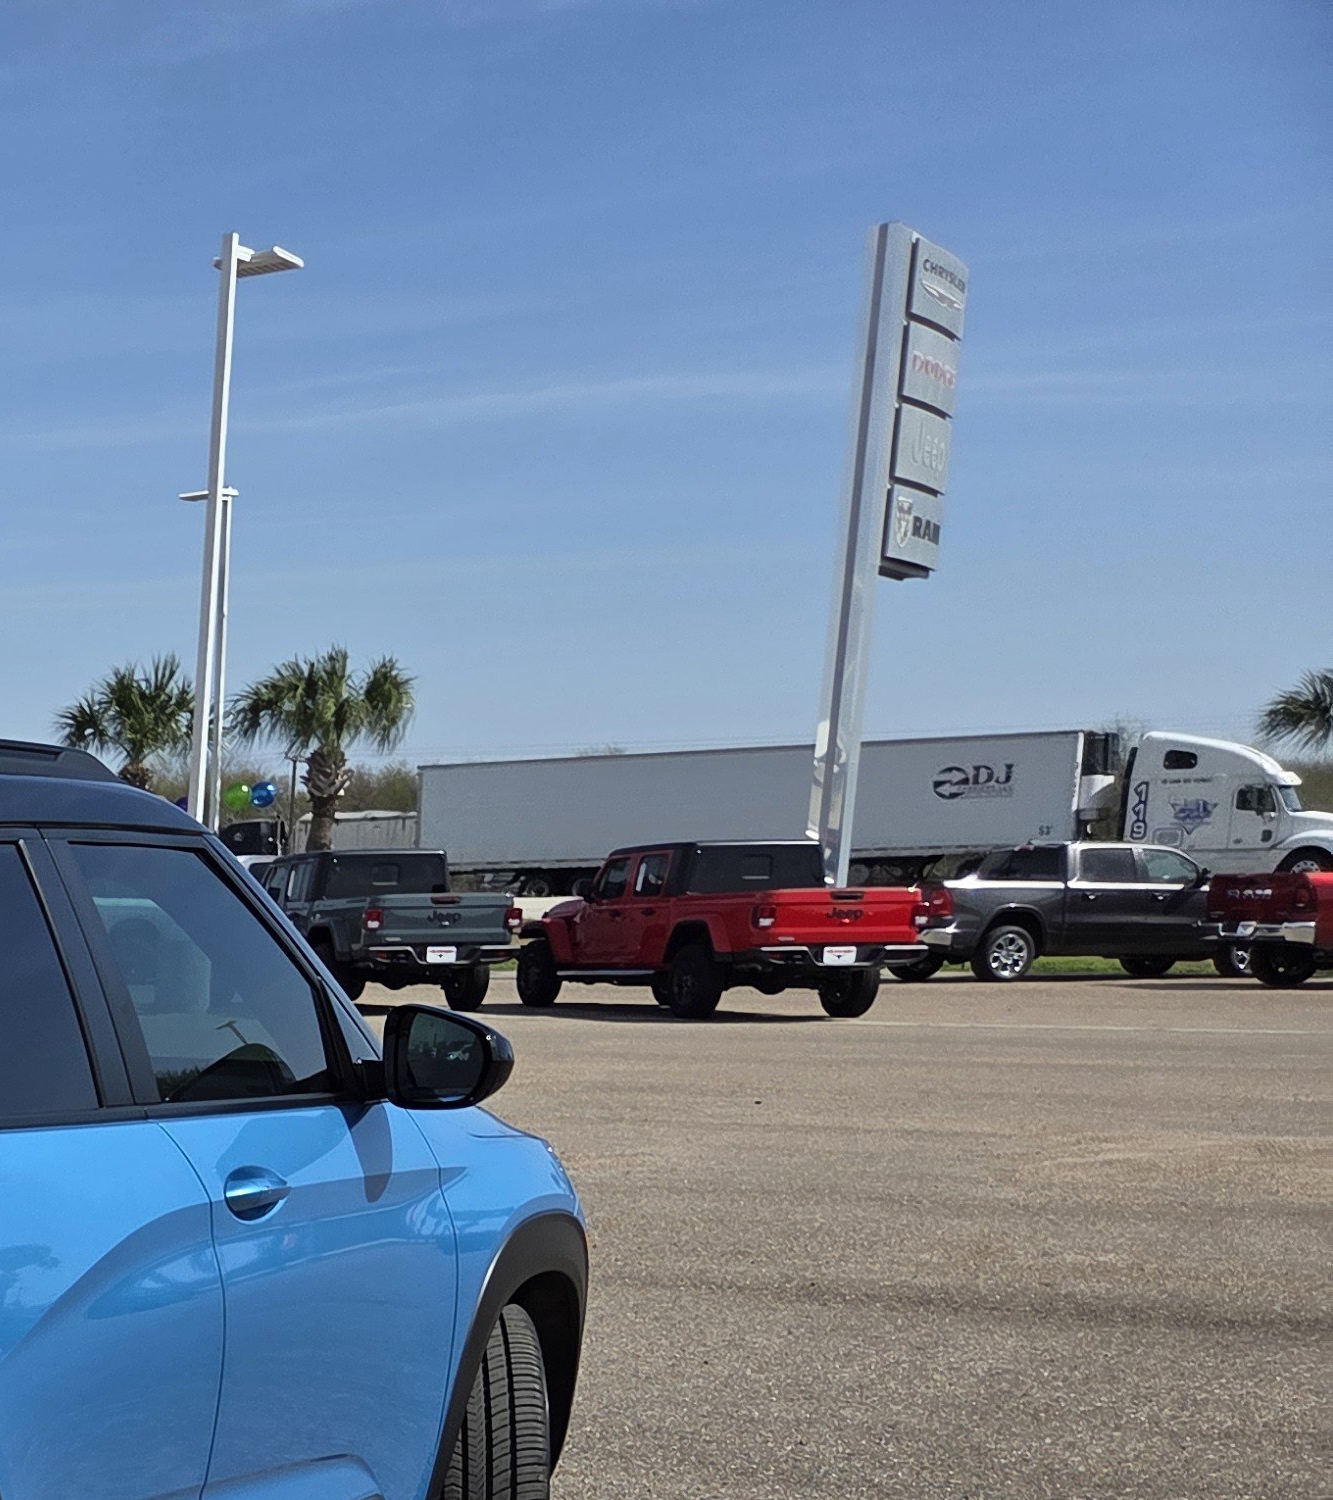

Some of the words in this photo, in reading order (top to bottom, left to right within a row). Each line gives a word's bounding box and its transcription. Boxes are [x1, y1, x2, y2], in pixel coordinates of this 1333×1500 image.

[971, 763, 1015, 786] DJ
[1129, 781, 1151, 841] 119
[426, 909, 462, 924] Jeep
[825, 906, 864, 921] Jeep
